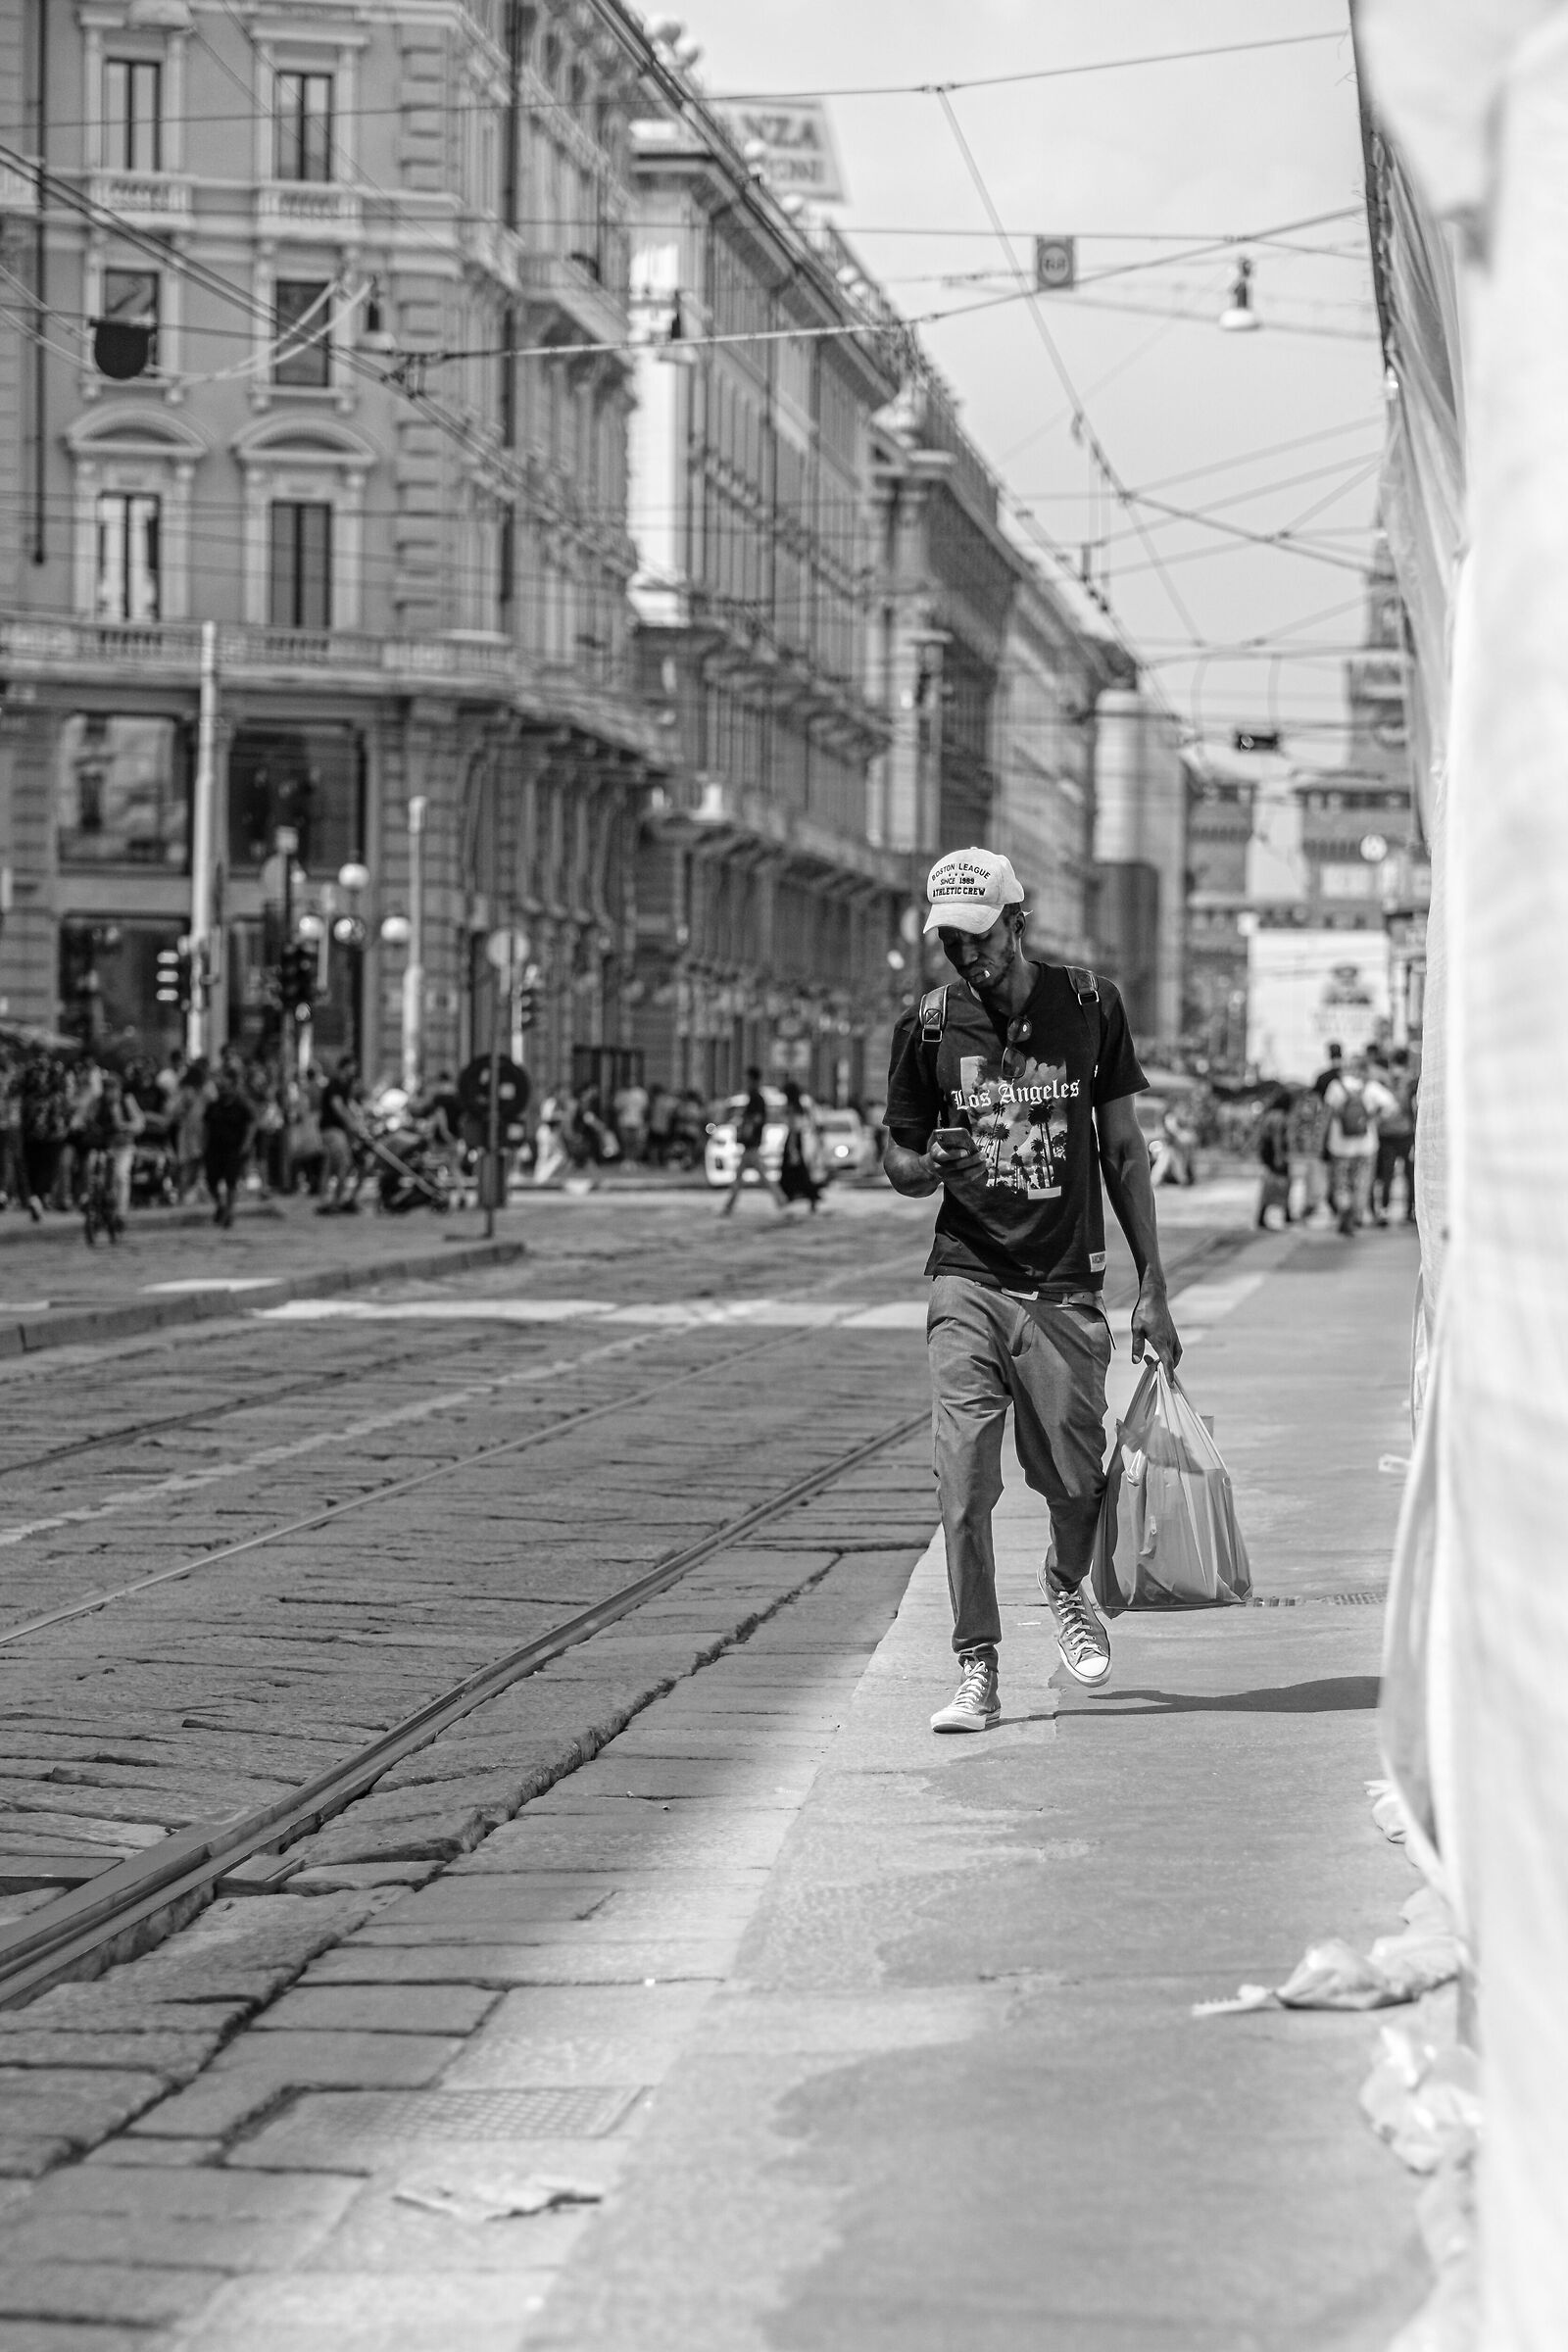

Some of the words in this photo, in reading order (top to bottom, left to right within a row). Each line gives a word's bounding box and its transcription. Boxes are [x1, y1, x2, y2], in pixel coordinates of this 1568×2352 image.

[931, 863, 956, 882] BOSTON
[958, 862, 991, 879] LEAGUE
[932, 887, 961, 898] ATHLETIC
[962, 887, 986, 897] CREW
[951, 1089, 992, 1110] Los
[998, 1078, 1081, 1105] Angeles
